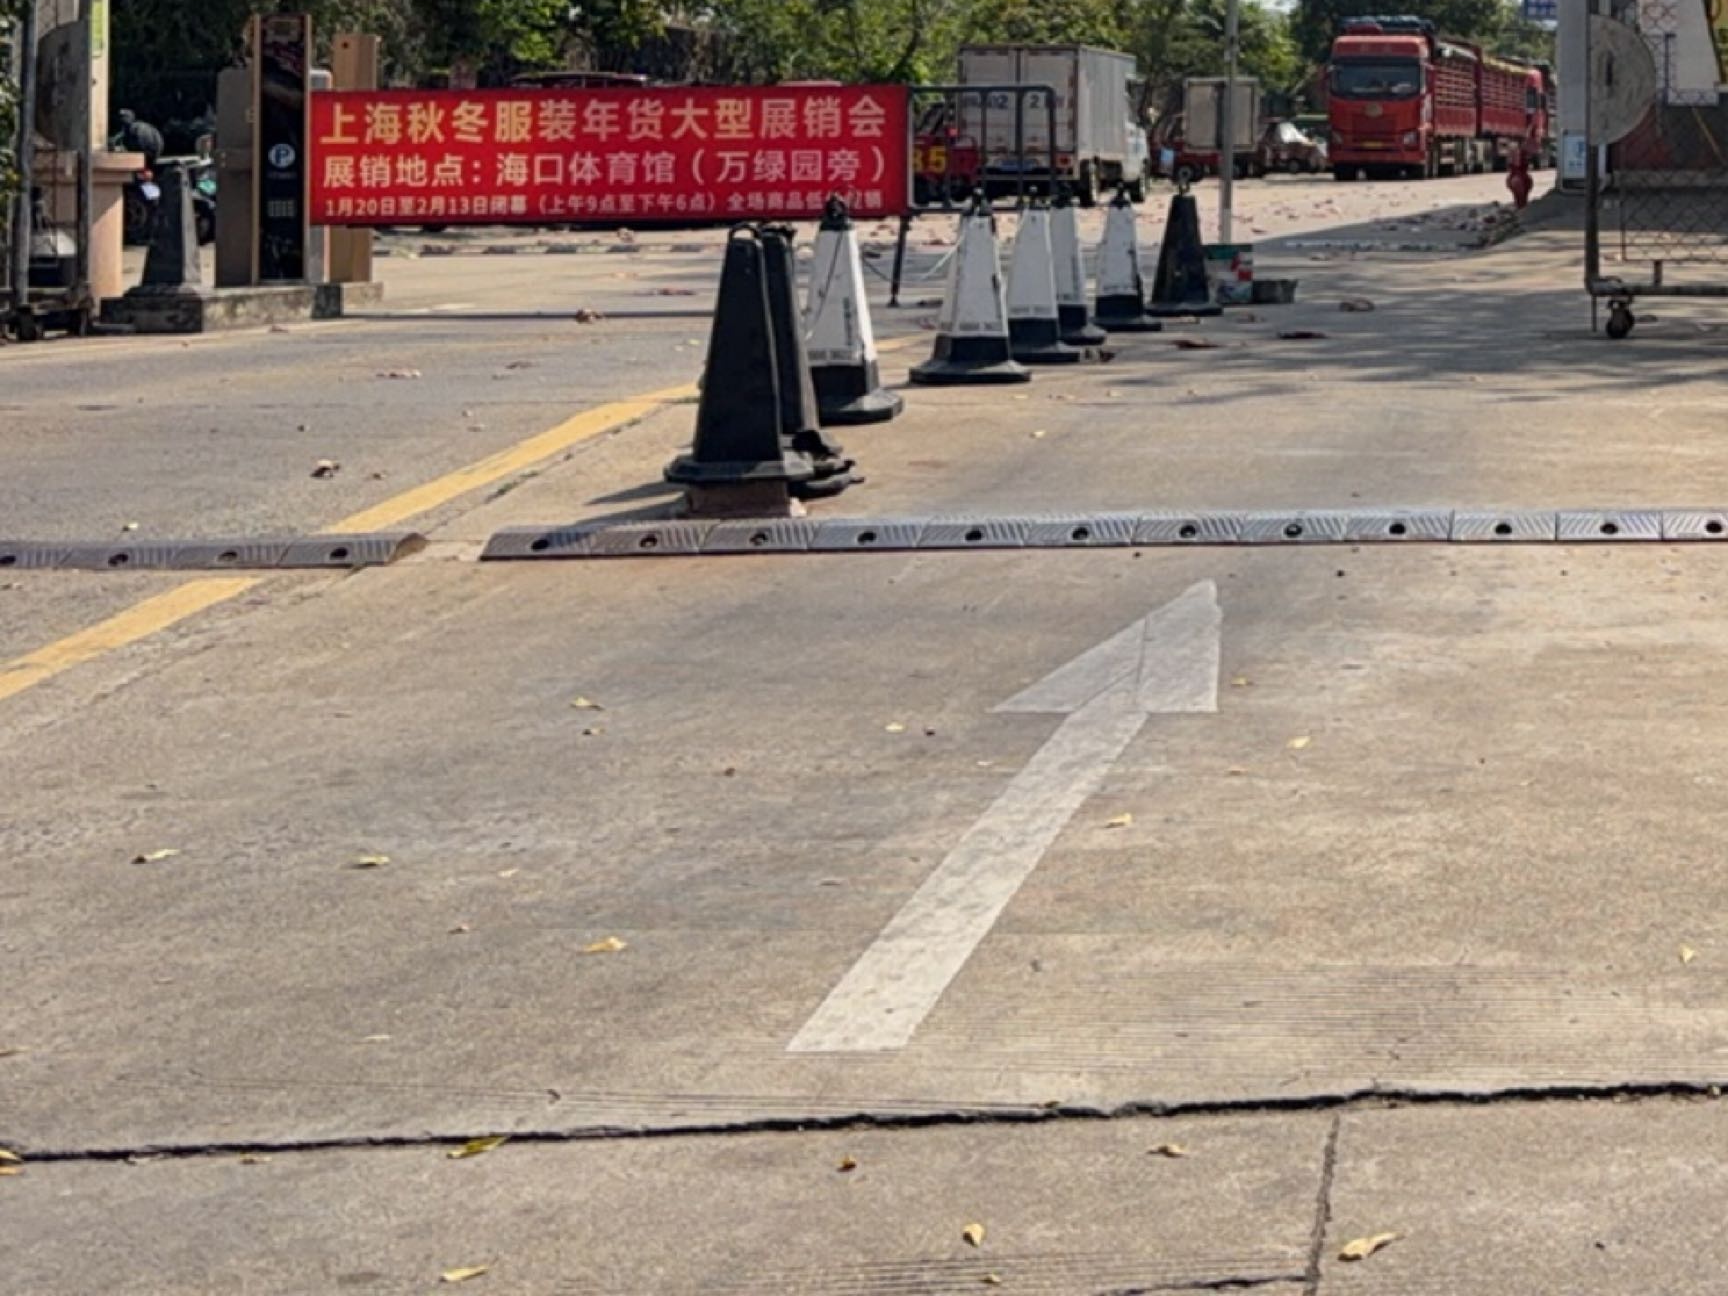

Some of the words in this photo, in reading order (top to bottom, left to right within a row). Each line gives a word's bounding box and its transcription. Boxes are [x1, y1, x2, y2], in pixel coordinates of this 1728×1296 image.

[320, 96, 887, 145] 上海秋冬服装年货大型展销会
